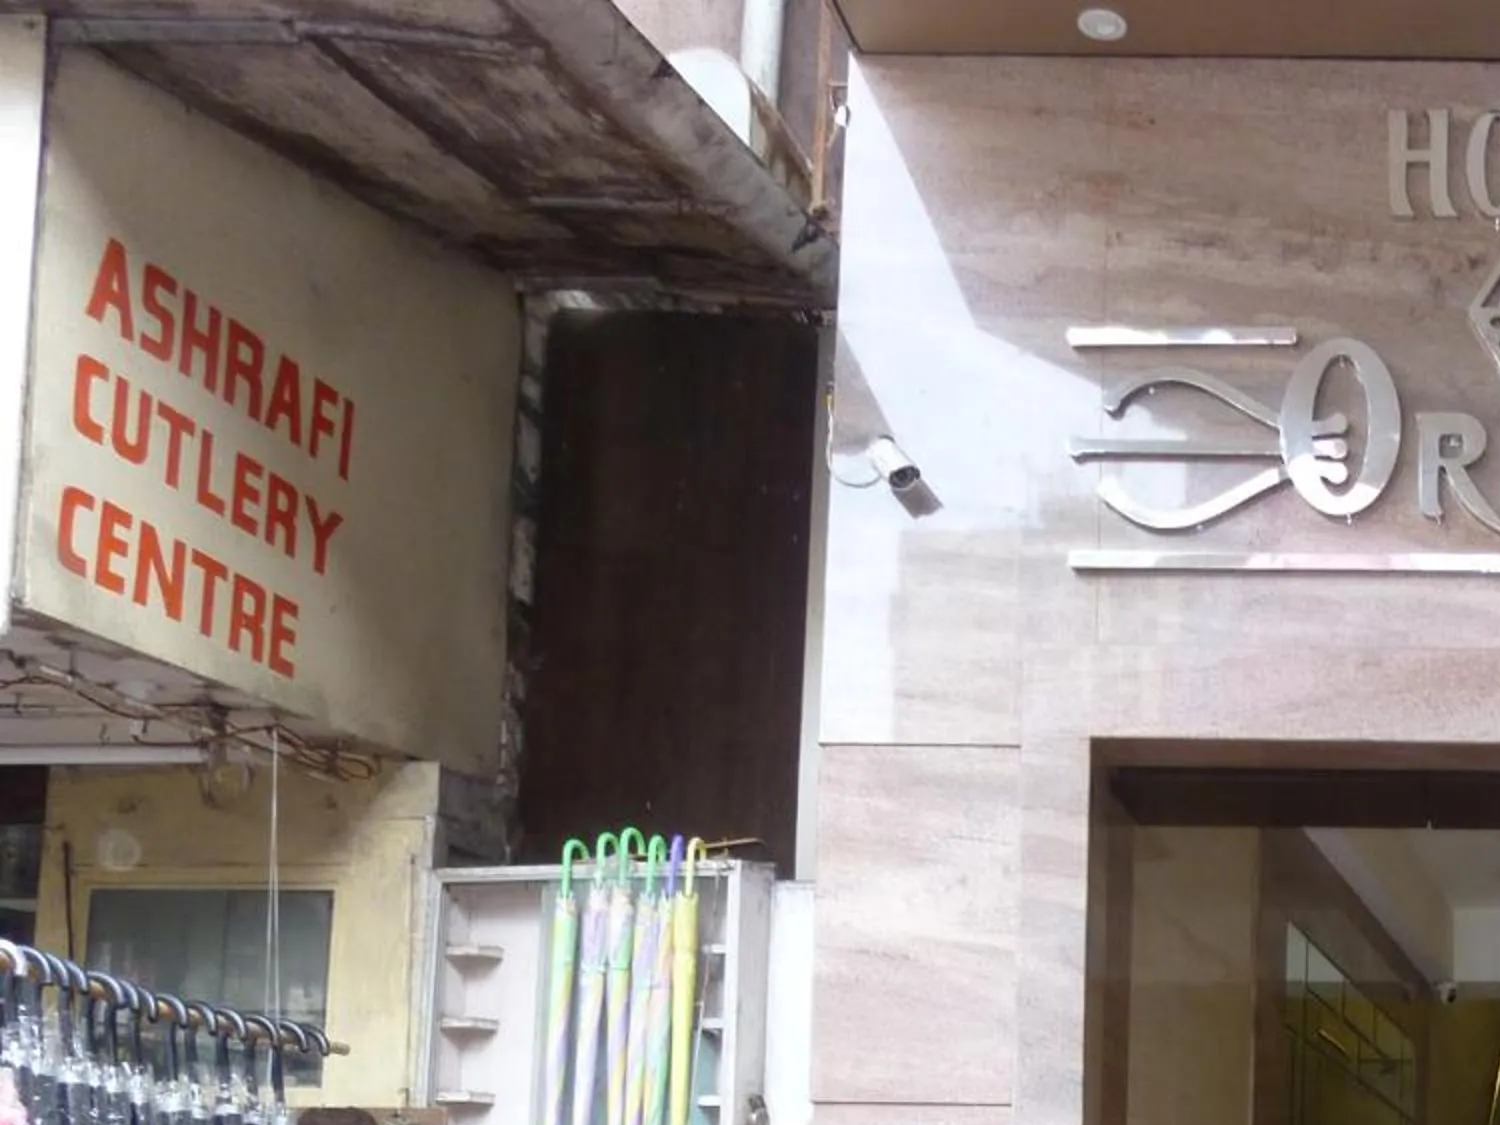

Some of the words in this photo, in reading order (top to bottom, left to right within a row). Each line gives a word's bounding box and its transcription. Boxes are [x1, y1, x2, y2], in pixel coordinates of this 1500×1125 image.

[72, 353, 344, 577] CUTLERY
[86, 237, 356, 482] ASHRAFI
[56, 485, 299, 680] CENTRE
